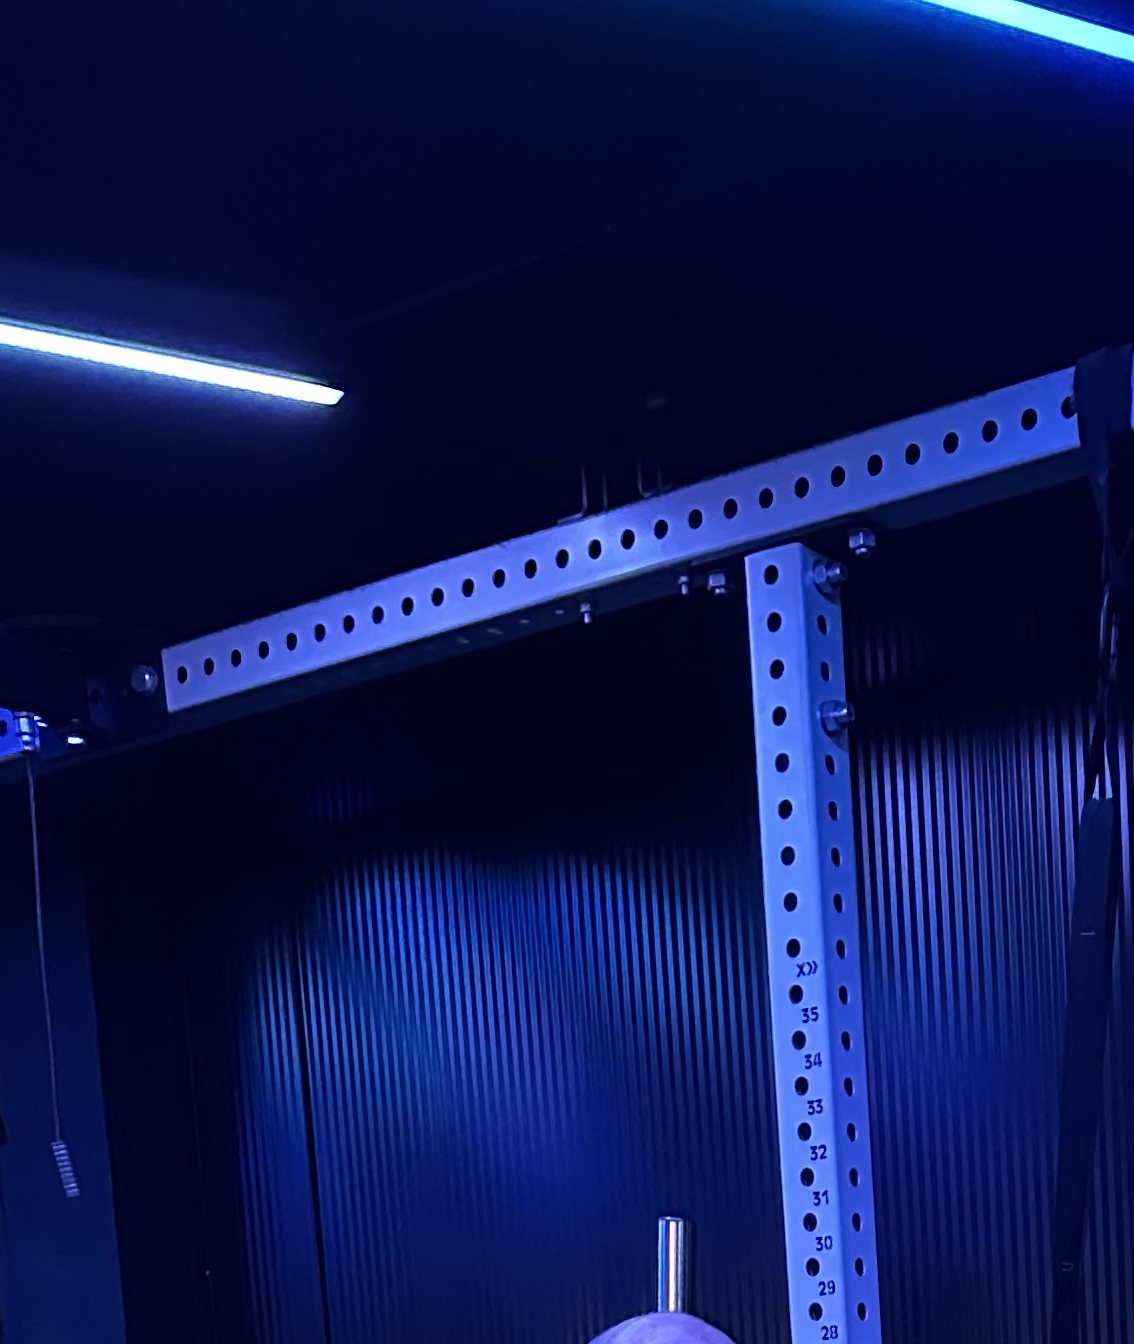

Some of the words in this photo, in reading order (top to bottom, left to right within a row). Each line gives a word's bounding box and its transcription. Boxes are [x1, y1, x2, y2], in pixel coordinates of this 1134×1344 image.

[801, 1006, 820, 1023] 35
[804, 1052, 823, 1070] 34
[807, 1099, 824, 1116] 33
[810, 1145, 828, 1161] 32
[812, 1190, 830, 1206] 31
[815, 1235, 834, 1252] 30
[818, 1280, 836, 1297] 29
[820, 1325, 839, 1341] 28
